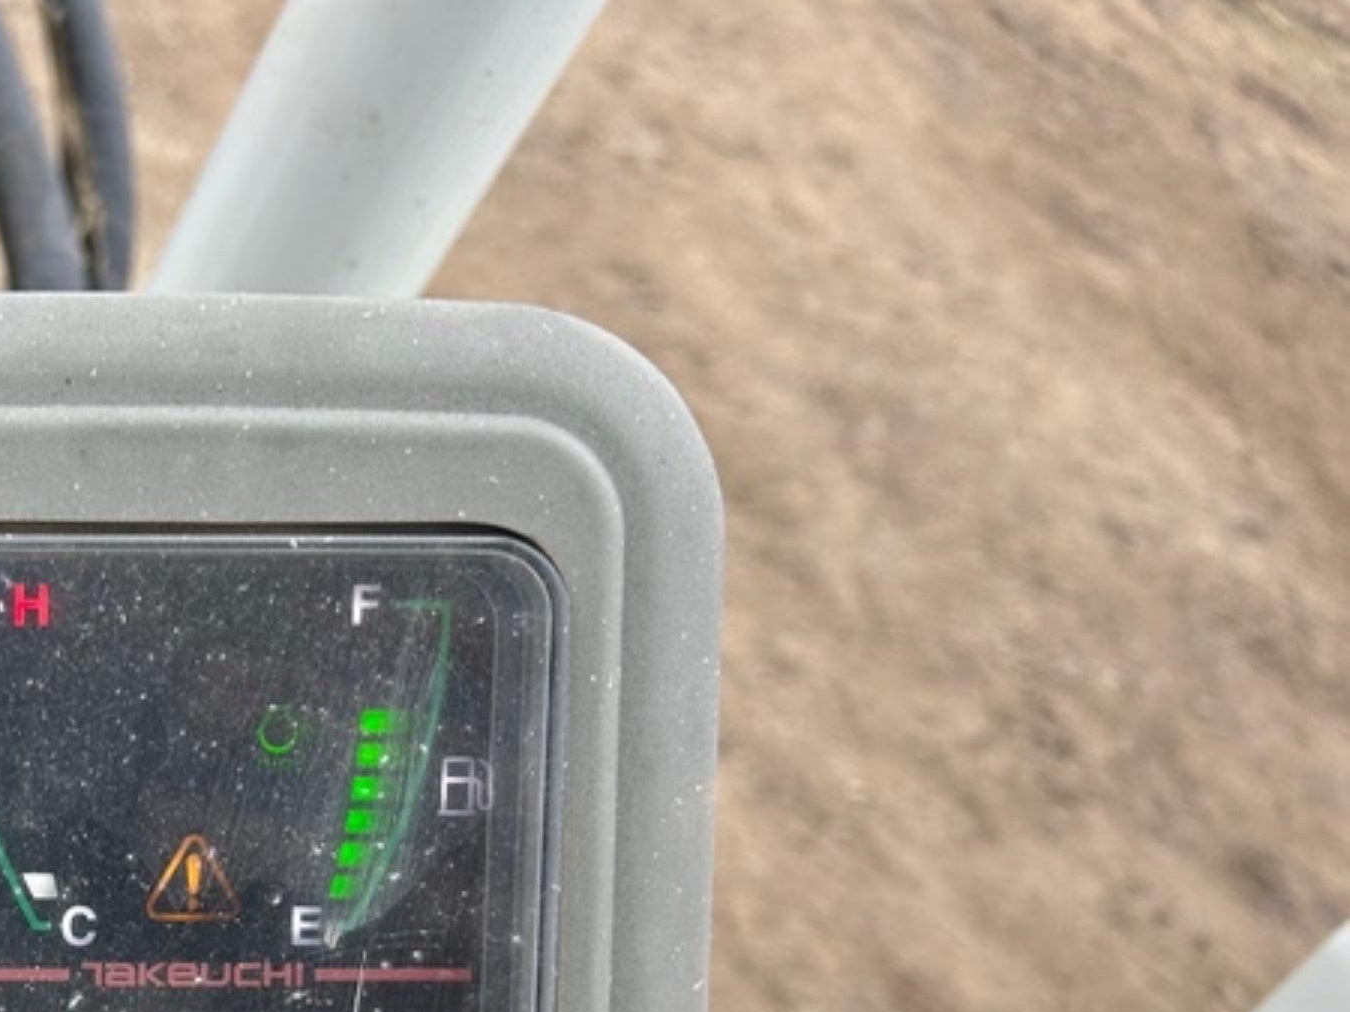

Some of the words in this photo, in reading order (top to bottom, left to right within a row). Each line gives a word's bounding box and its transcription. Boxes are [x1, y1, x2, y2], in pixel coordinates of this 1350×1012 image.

[11, 584, 51, 627] H
[351, 584, 380, 626] F
[60, 905, 98, 947] C
[291, 905, 322, 946] E
